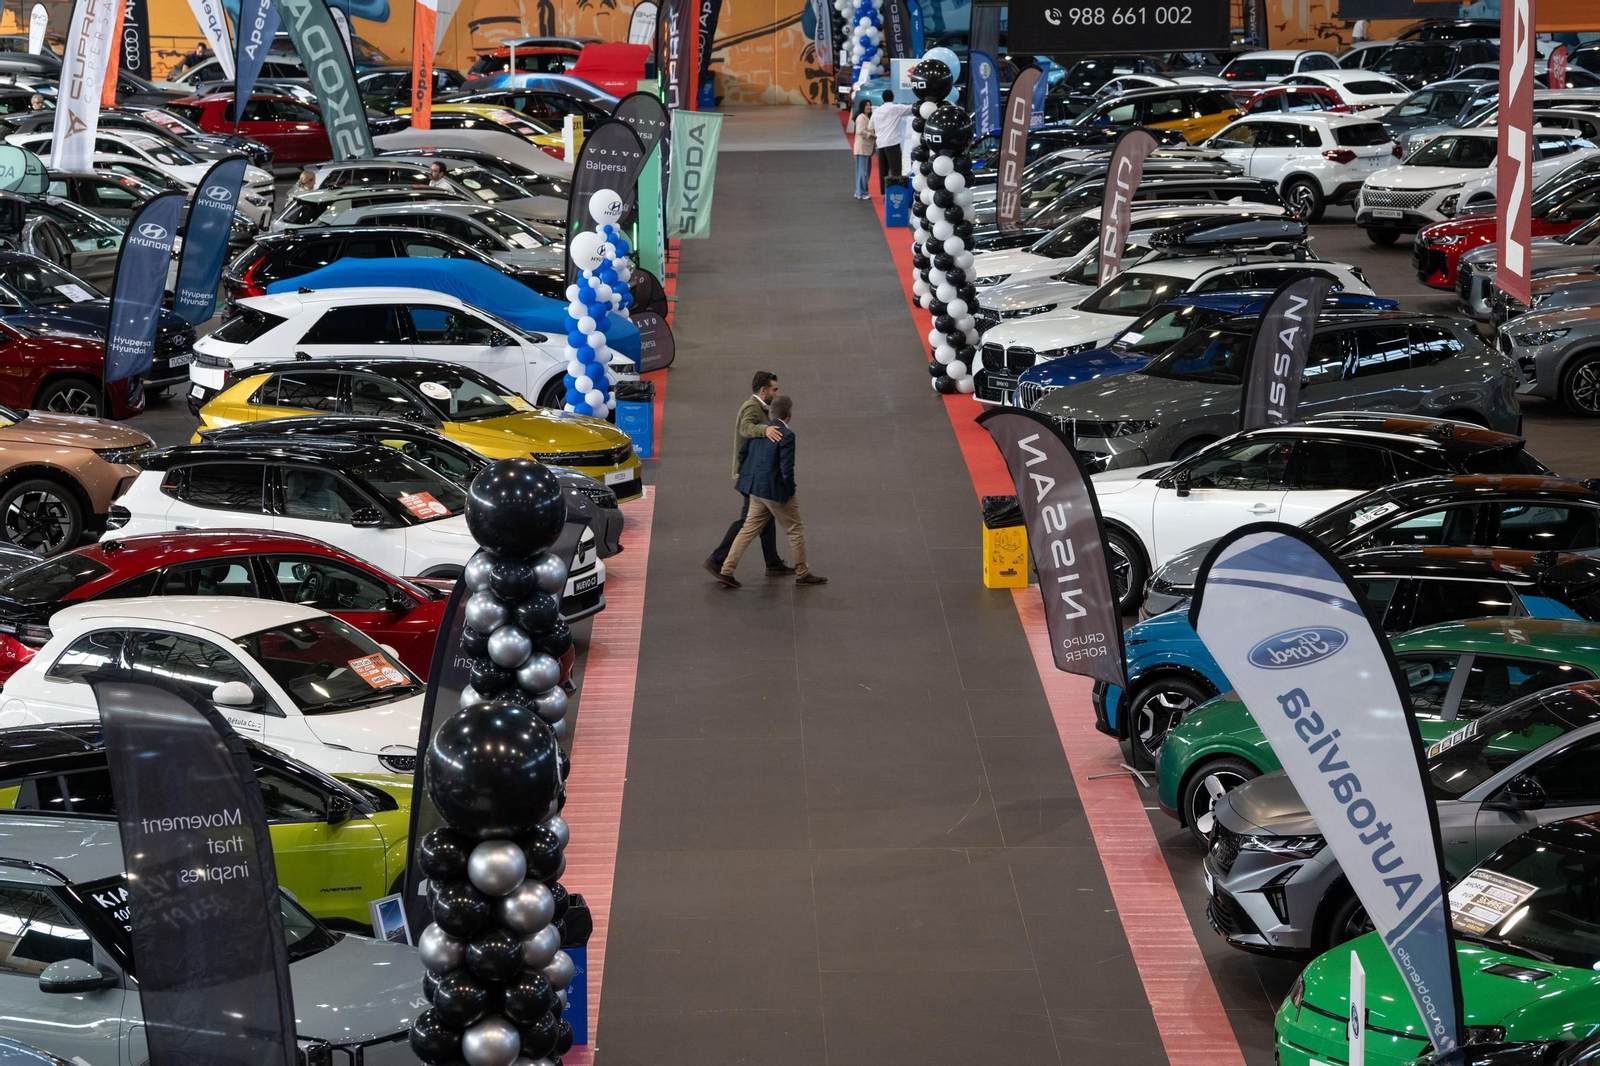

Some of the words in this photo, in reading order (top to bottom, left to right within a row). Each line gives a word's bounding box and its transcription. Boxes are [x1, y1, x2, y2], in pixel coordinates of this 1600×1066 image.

[1068, 8, 1105, 26] 988
[1111, 7, 1146, 25] 661
[1155, 7, 1193, 24] 002
[618, 117, 665, 127] VOLVO
[588, 148, 639, 158] VOLVO
[586, 160, 627, 173] Balpersa
[198, 199, 235, 212] HYUNDAI
[129, 235, 171, 252] HYUNDAI
[180, 297, 209, 307] Hyunda
[637, 317, 657, 328] LVO
[113, 335, 151, 347] Hyupersa
[112, 343, 146, 355] Hyundai
[1267, 294, 1309, 419] ISSAN
[576, 578, 591, 591] NUEVO
[591, 576, 597, 586] C3
